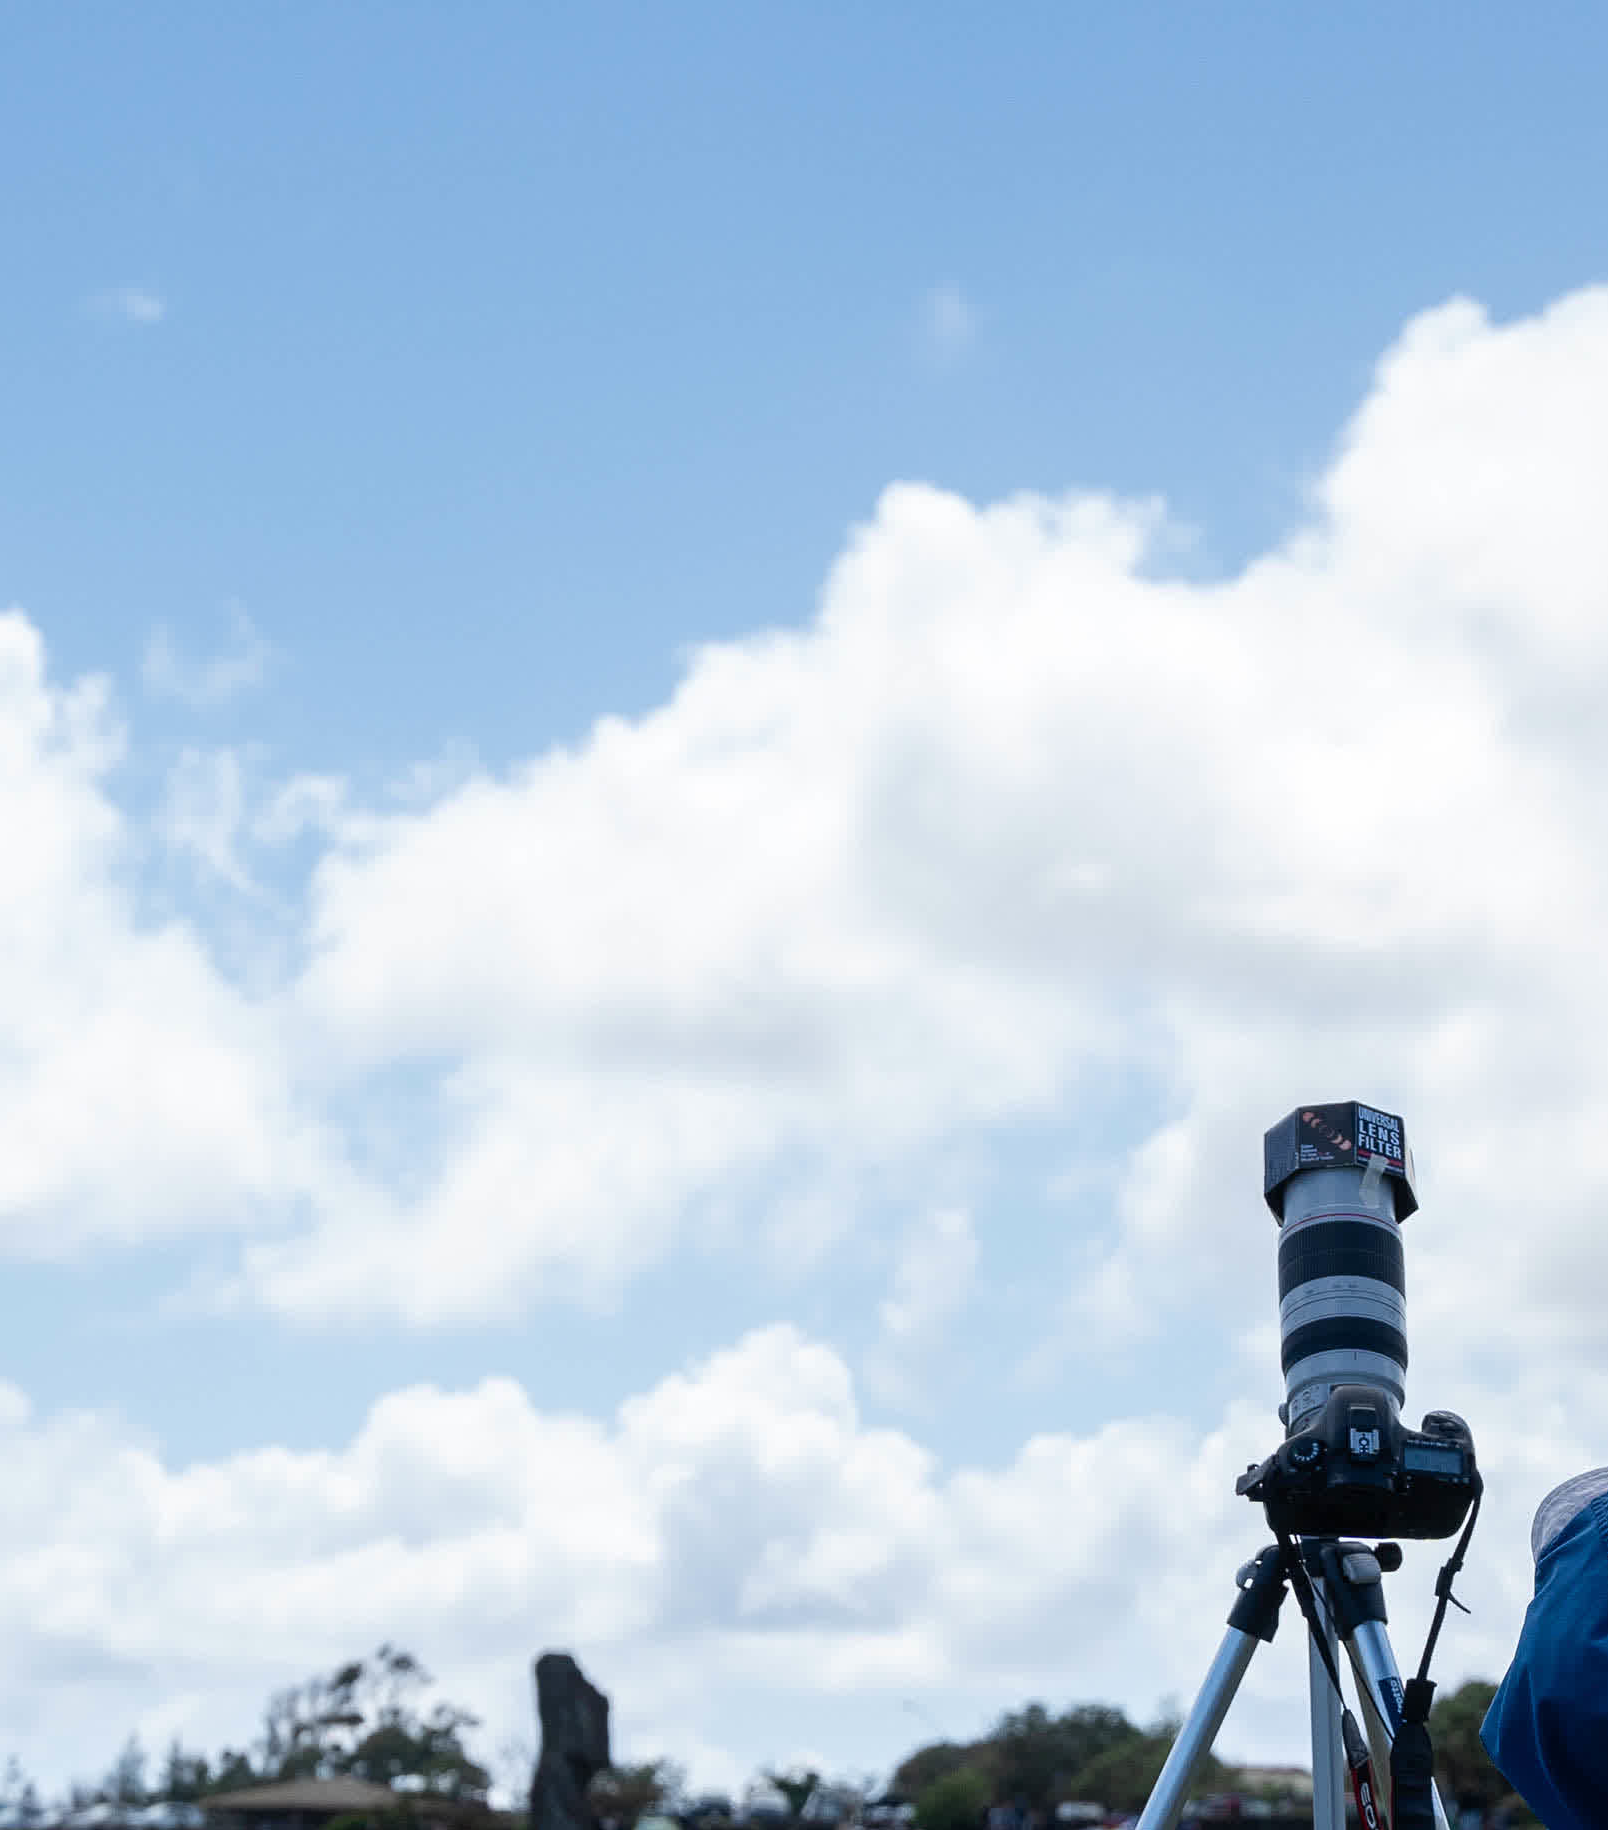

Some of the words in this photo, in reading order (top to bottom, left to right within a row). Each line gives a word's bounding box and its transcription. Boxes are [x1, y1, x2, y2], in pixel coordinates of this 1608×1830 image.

[1358, 1105, 1399, 1132] UNIVERSAL
[1358, 1120, 1400, 1145] LENS
[1358, 1134, 1401, 1160] FILTER
